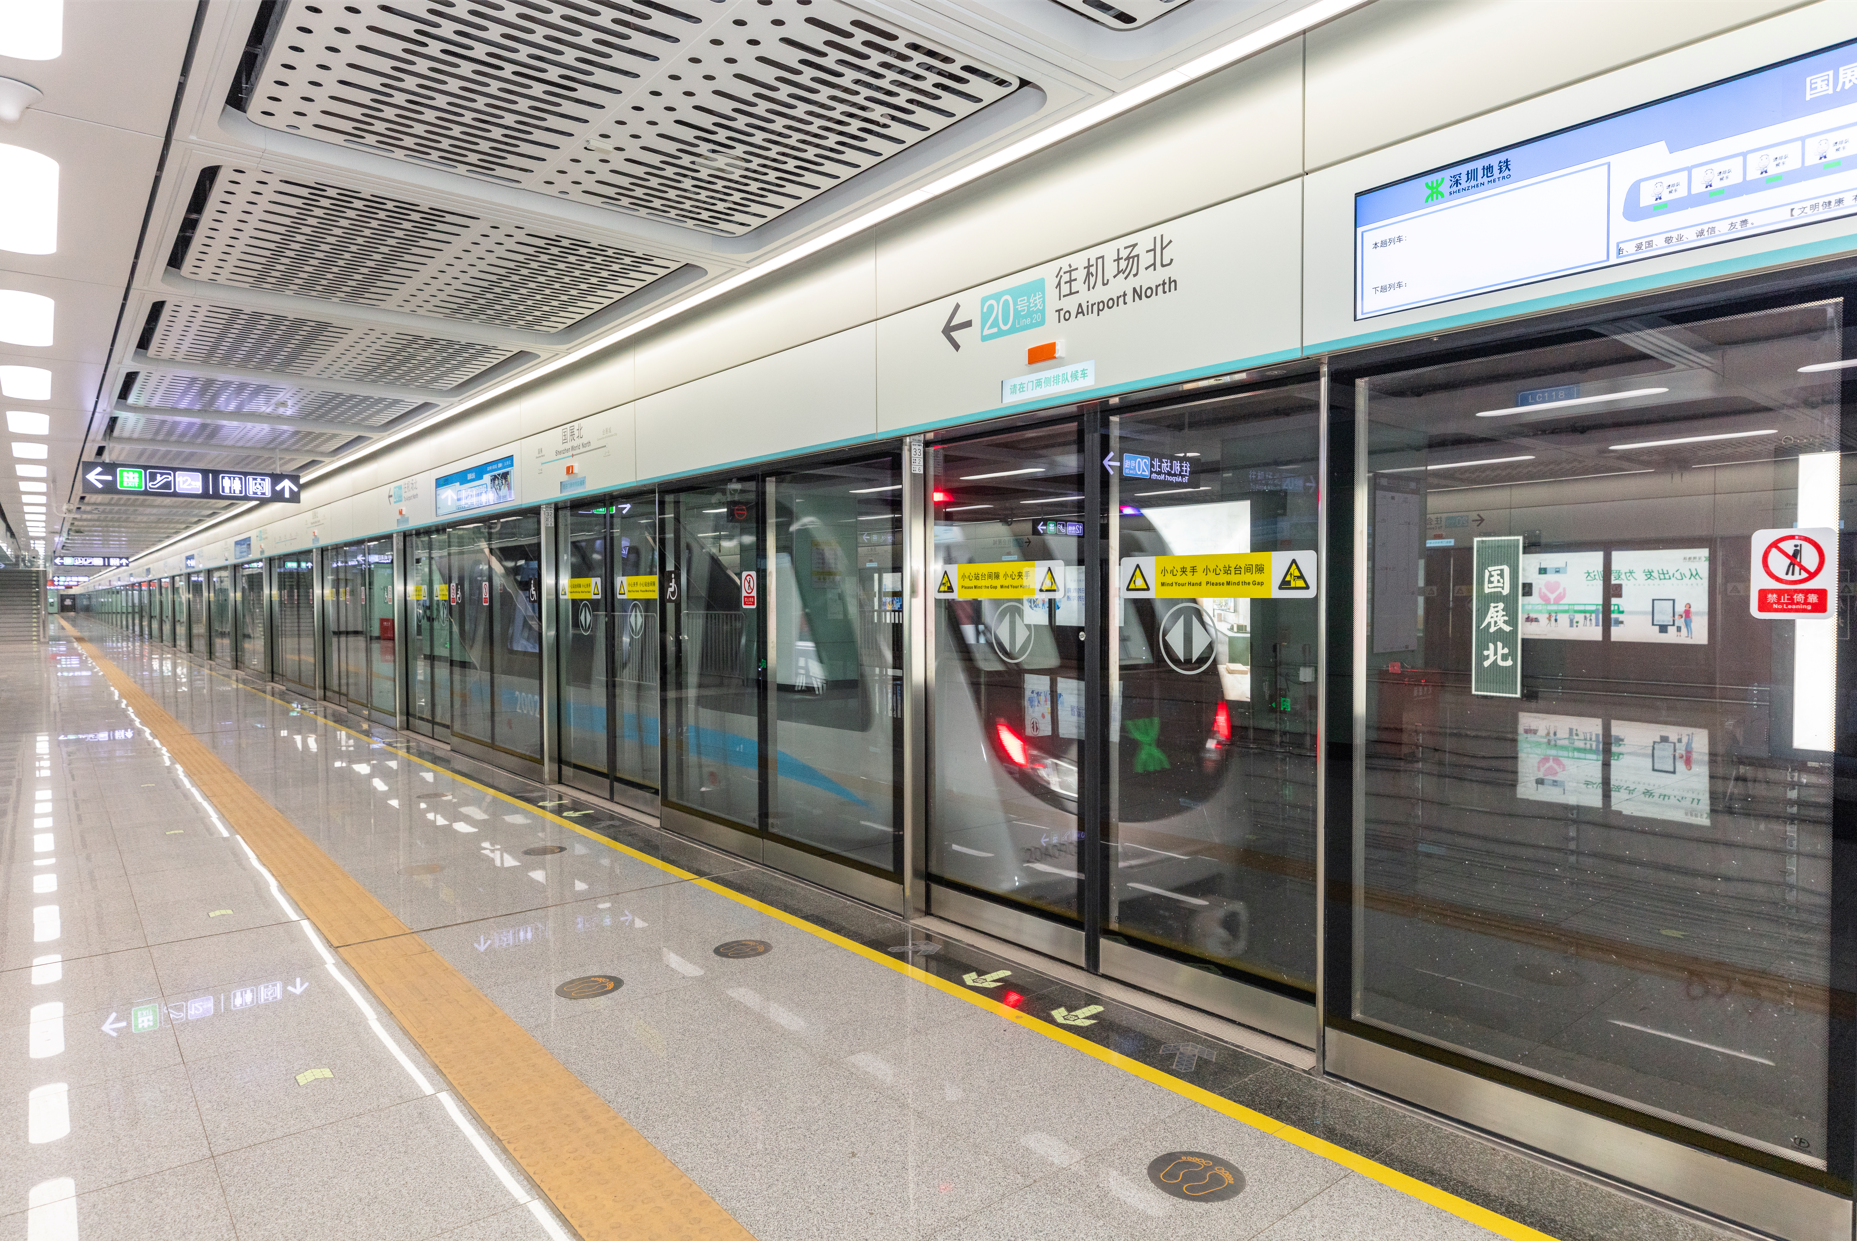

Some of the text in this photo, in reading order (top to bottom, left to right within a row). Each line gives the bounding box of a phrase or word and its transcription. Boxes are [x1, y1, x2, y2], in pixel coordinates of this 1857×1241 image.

[1448, 174, 1511, 196] SHENZHEN METRO
[1449, 158, 1511, 188] 深圳地铁
[1055, 233, 1174, 301] 往机场北
[1055, 277, 1178, 324] To Airport North
[1016, 313, 1042, 328] Line 20
[1009, 368, 1089, 396] 请在门两侧排队候车
[961, 570, 1030, 581] 小心站台间隙 小心夹手
[1160, 563, 1265, 577] 小心夹手 小心站台间隙
[1767, 593, 1819, 604] 禁止倚靠
[1480, 565, 1513, 668] 国展北
